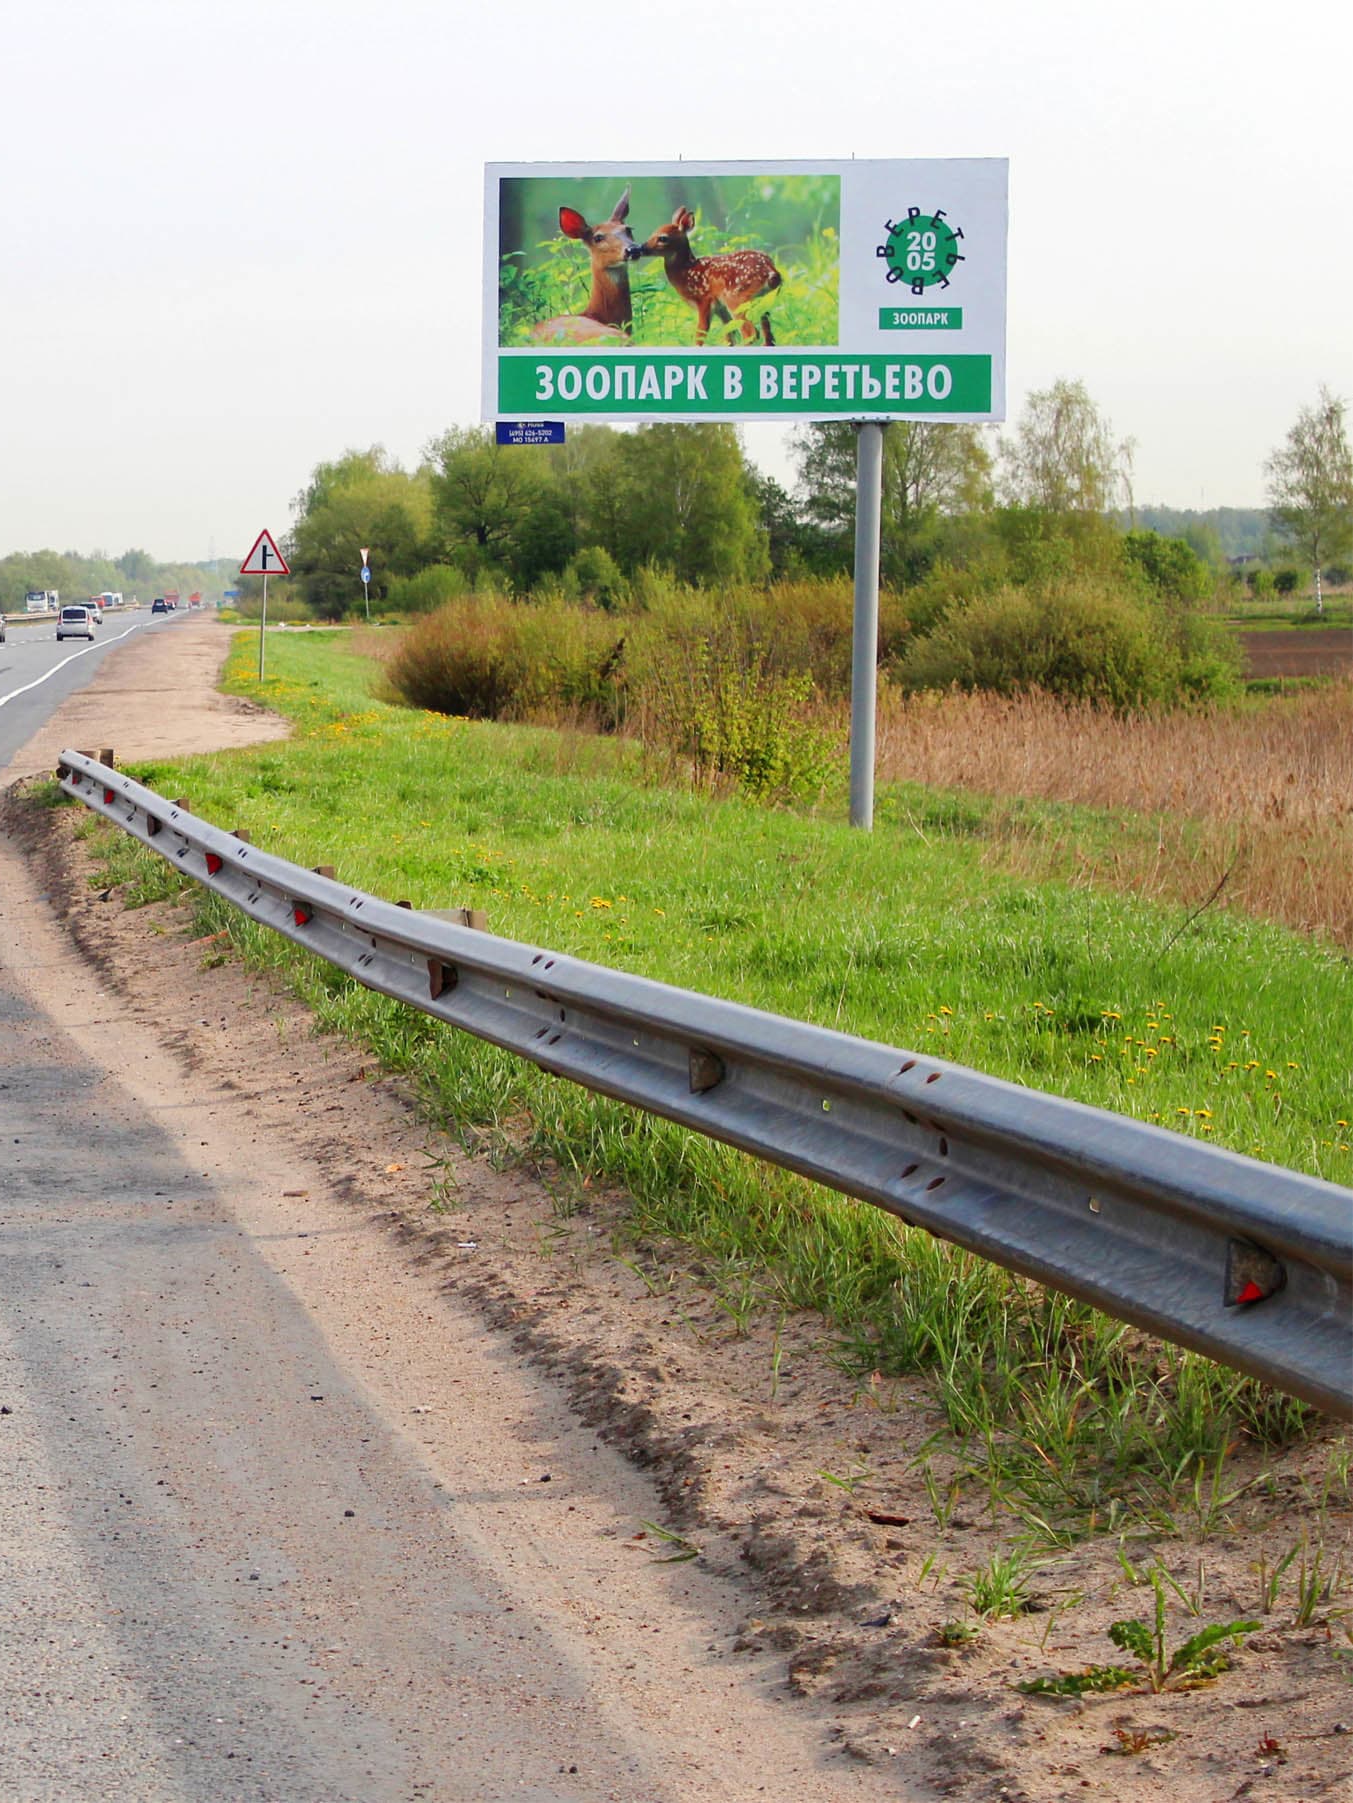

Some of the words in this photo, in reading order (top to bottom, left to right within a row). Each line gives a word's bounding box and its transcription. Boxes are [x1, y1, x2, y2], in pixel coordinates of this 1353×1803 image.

[876, 206, 966, 296] ВЕРЕТЬЕВО
[906, 231, 937, 251] 20
[906, 251, 936, 271] 05
[892, 312, 949, 325] ЗООПАРК
[535, 364, 709, 400] ЗООПАРК
[723, 364, 744, 400] В
[759, 363, 953, 400] ВЕРЕТЬЕВО
